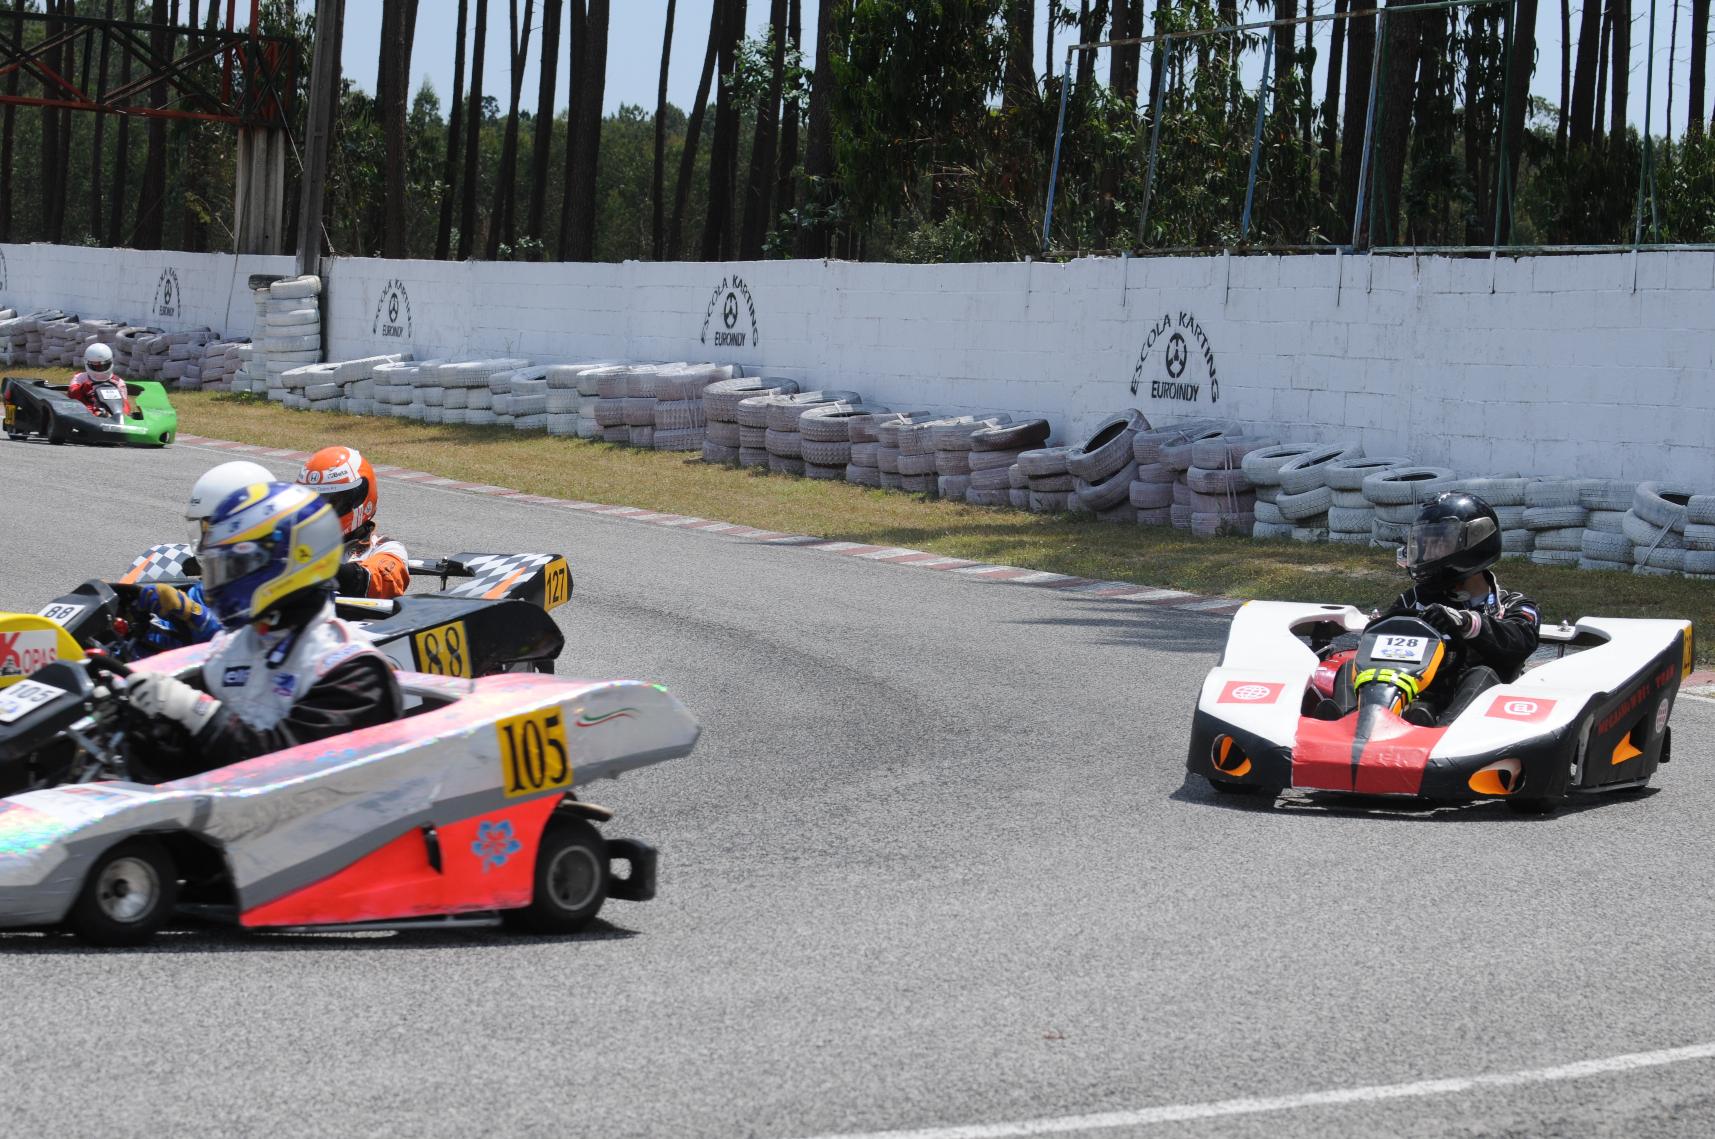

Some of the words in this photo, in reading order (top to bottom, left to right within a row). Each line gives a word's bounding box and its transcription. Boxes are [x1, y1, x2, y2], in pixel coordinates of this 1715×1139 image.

[701, 277, 728, 345] ESCOLA
[732, 274, 759, 348] KARTING
[715, 331, 746, 347] EUROINDY
[1130, 313, 1171, 397] ESCOLA
[1179, 311, 1220, 404] KARTING
[1151, 380, 1200, 402] EUROINDY
[546, 567, 565, 605] 127
[44, 605, 75, 620] 88
[424, 626, 463, 678] 88
[1385, 637, 1419, 648] 128
[9, 684, 55, 702] 105
[503, 715, 568, 793] 105
